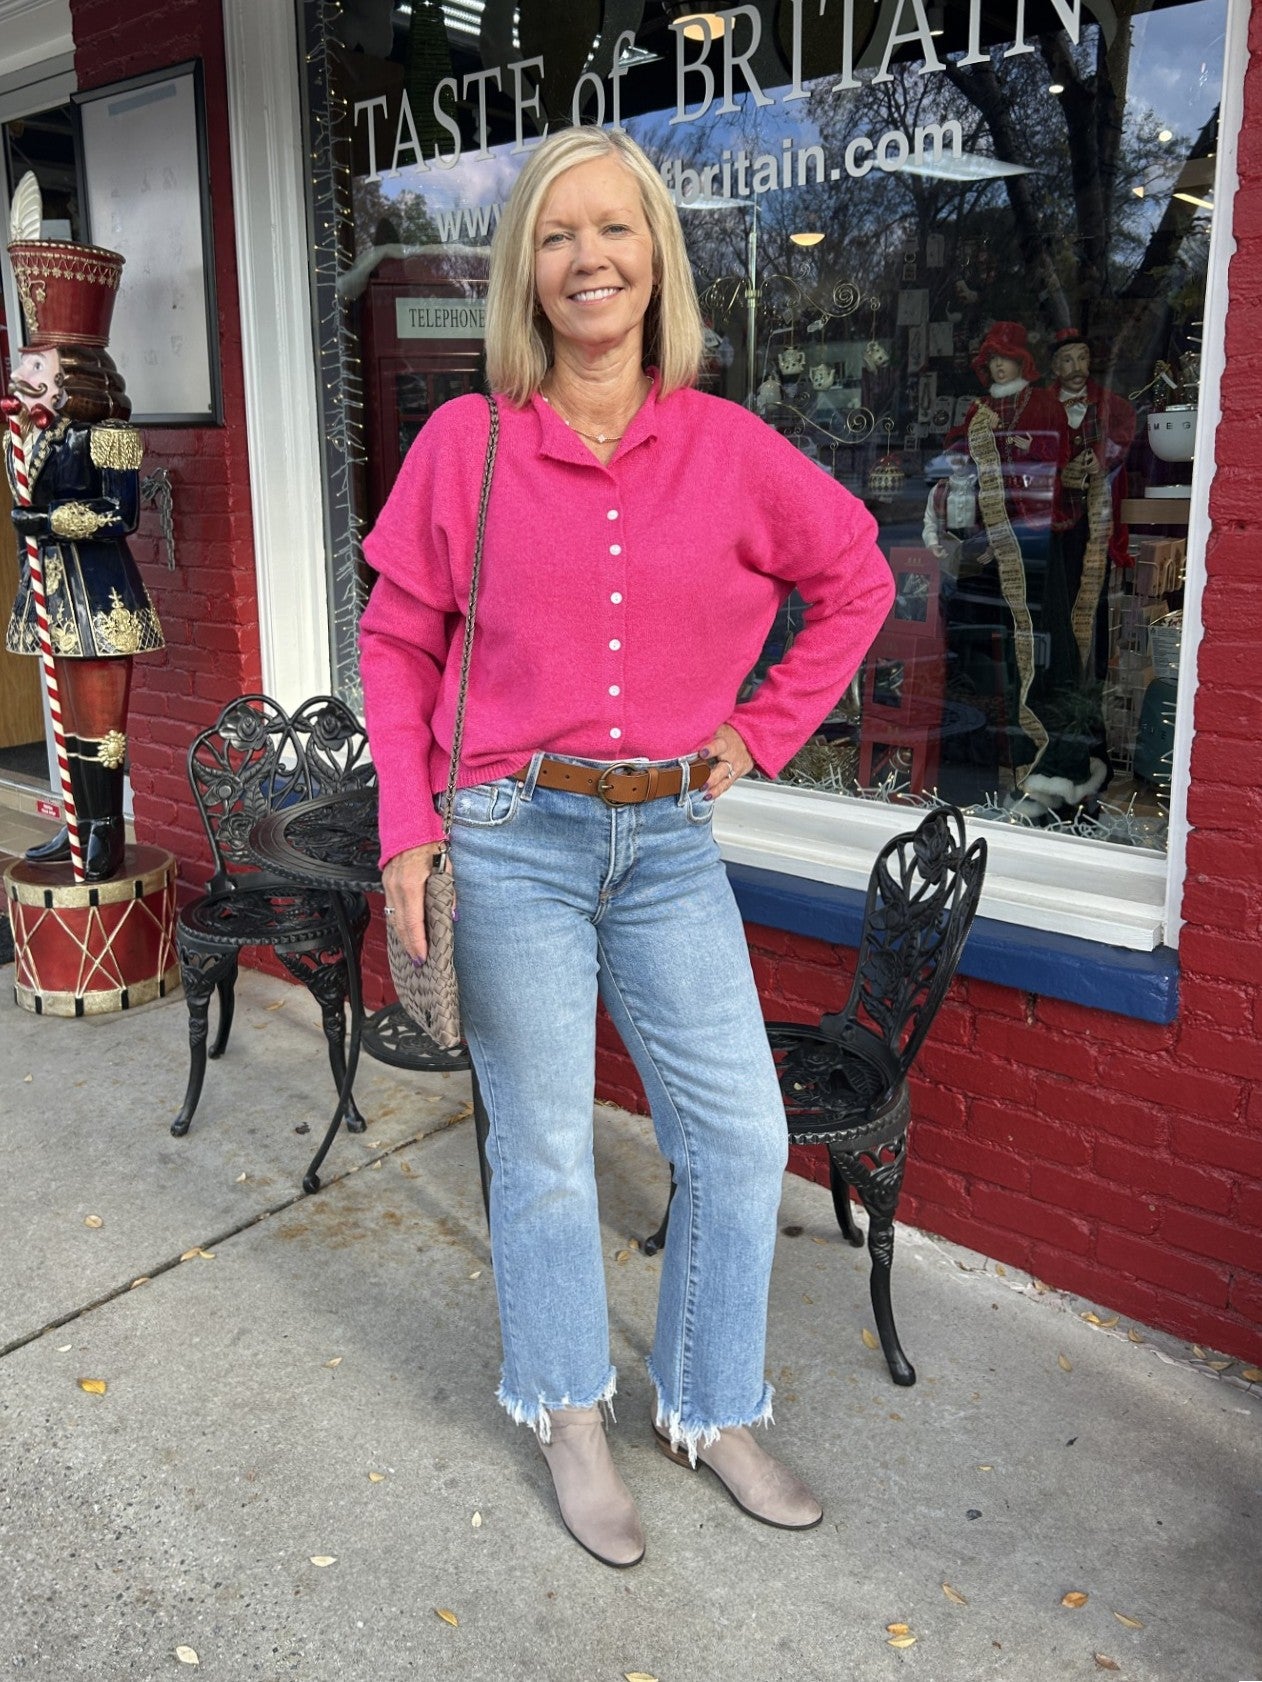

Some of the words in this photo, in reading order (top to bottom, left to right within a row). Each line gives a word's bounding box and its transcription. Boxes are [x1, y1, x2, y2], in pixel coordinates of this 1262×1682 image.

[354, 55, 549, 184] TASTE
[572, 30, 636, 134] of
[436, 203, 502, 243] ww
[408, 308, 486, 329] TELEPHONE
